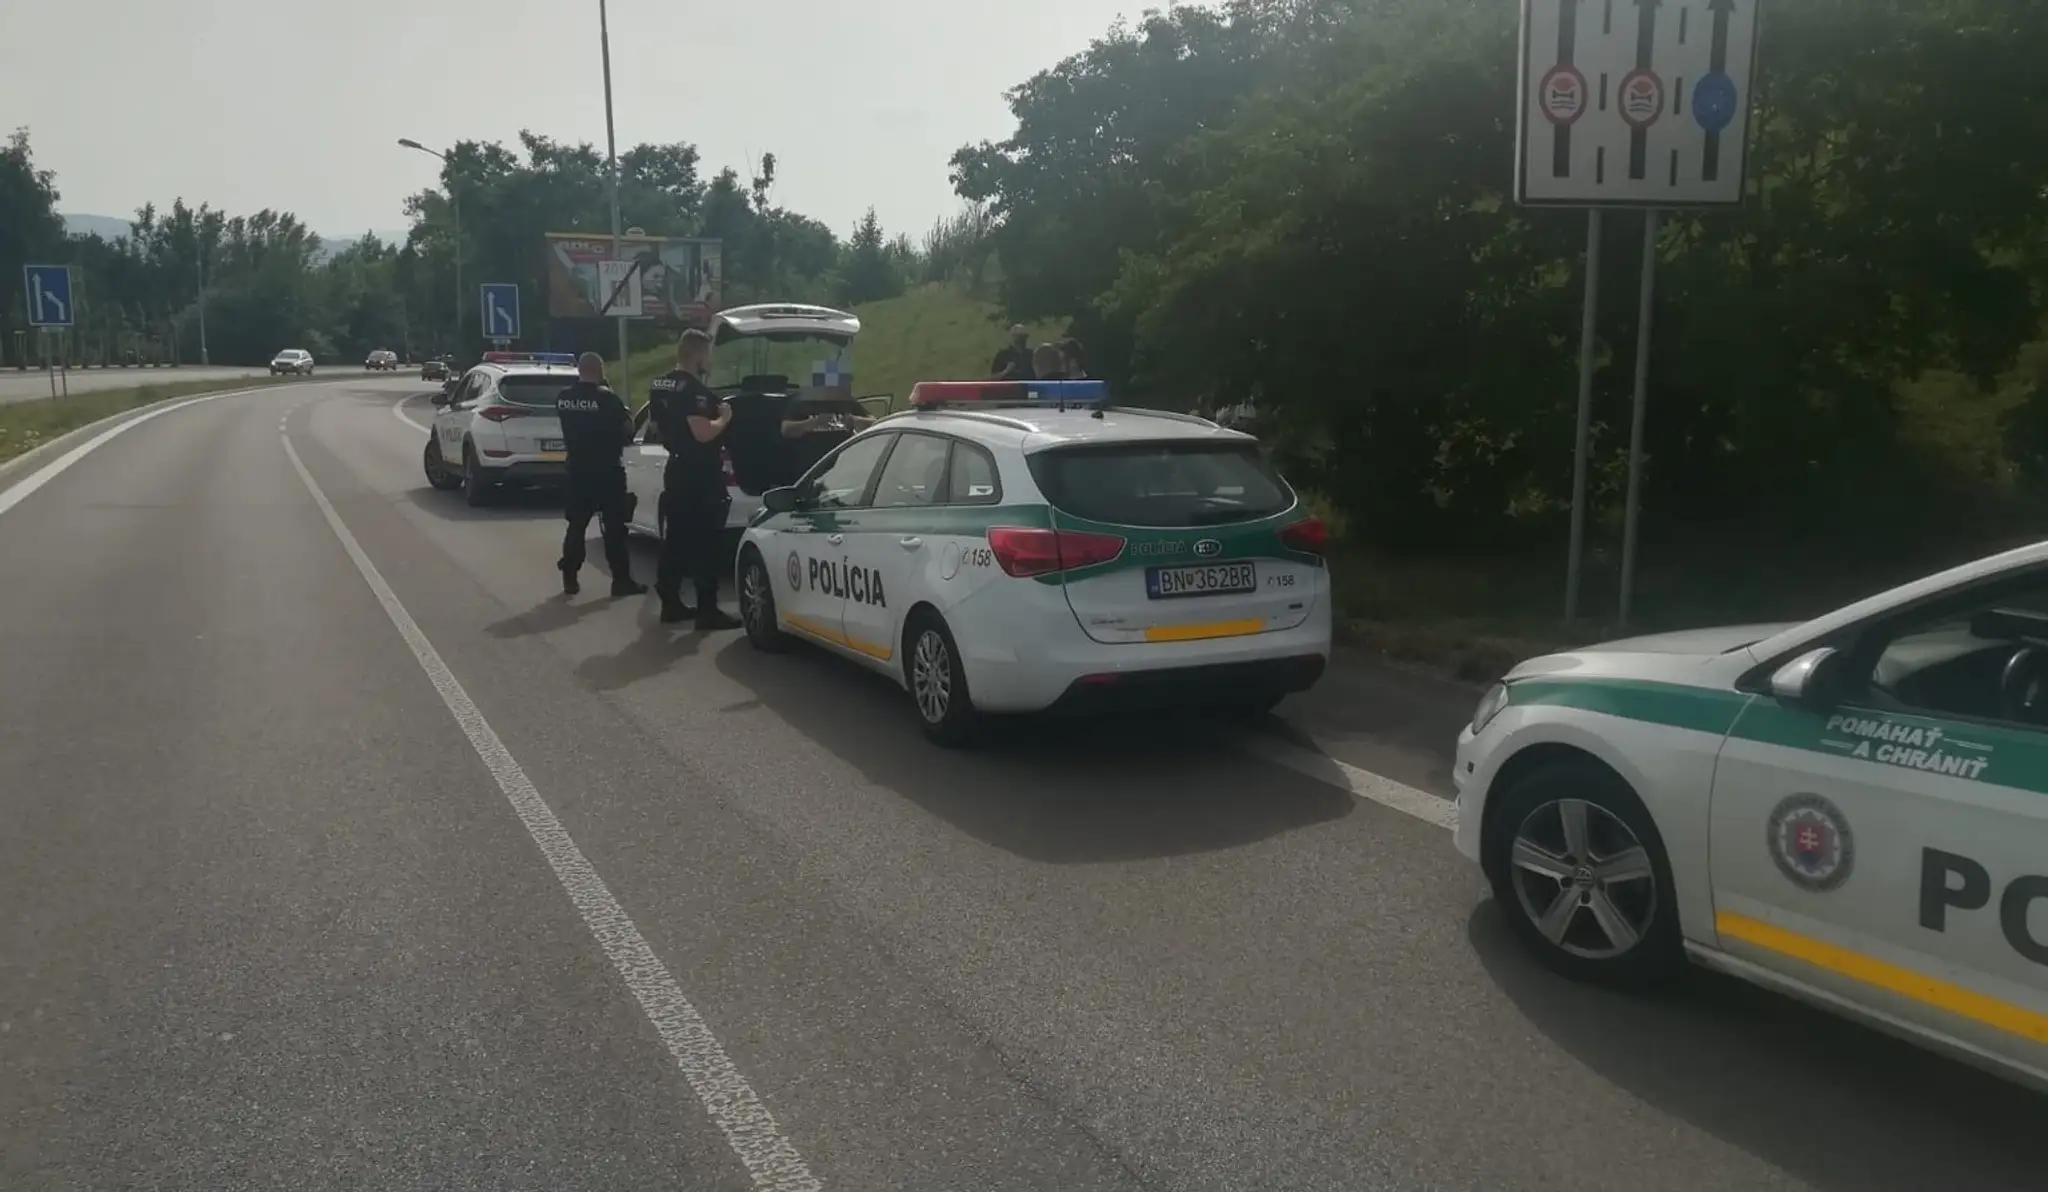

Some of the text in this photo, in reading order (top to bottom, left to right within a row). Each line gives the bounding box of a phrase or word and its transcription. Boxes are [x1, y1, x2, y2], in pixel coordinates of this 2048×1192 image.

[972, 548, 991, 567] 158
[808, 556, 887, 608] POLÍCIA
[1276, 575, 1295, 587] 158
[1826, 714, 1943, 748] POMÁHAŤ
[1852, 741, 1989, 779] A CHRÁNIŤ
